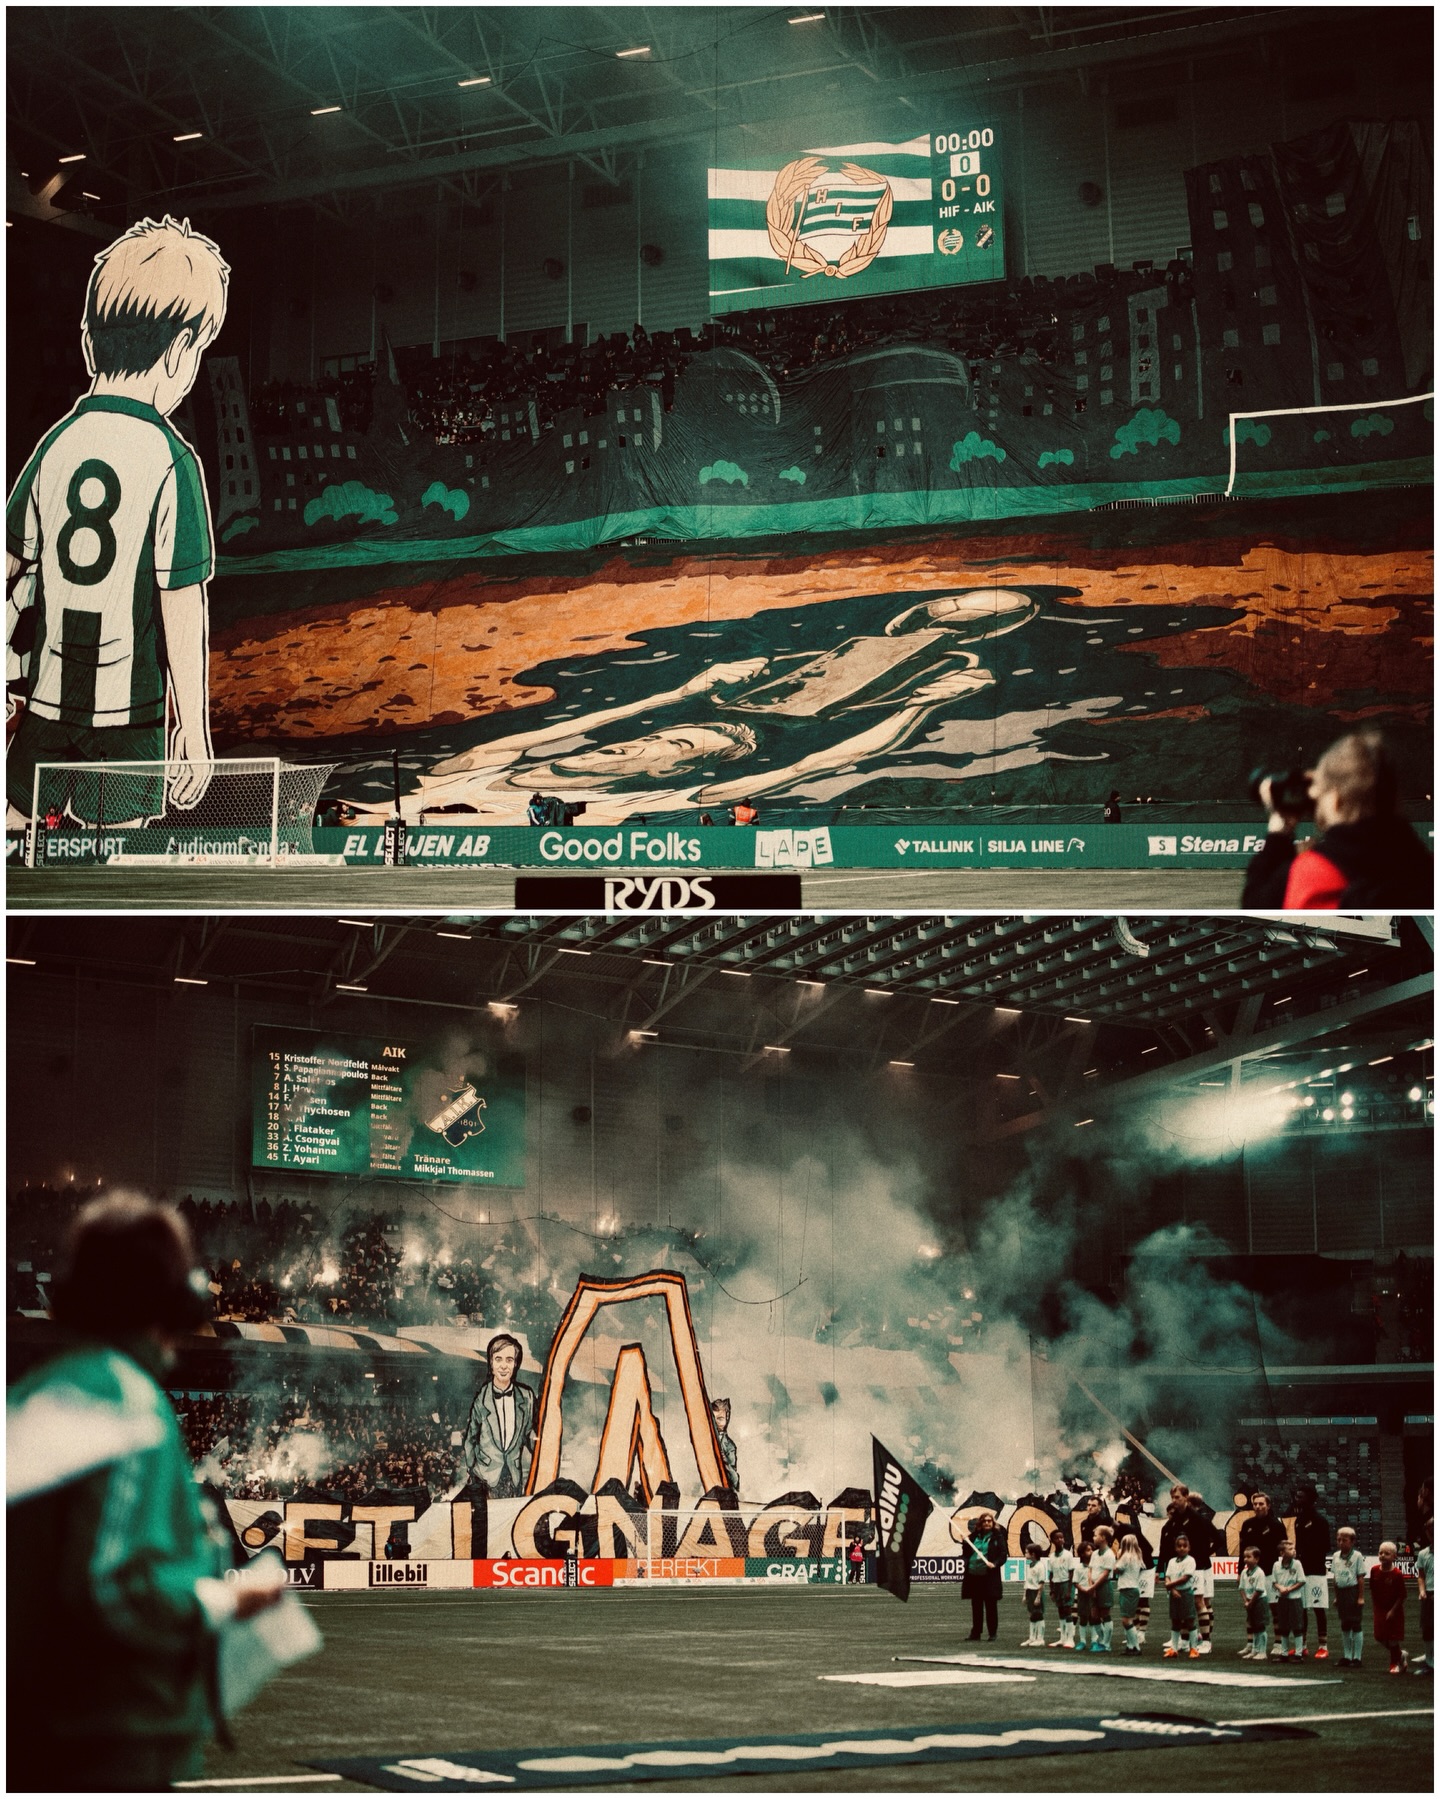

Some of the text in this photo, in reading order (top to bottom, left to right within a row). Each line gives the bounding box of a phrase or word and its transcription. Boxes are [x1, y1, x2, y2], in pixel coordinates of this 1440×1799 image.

[935, 128, 994, 154] 00:00
[960, 155, 971, 173] 0
[942, 179, 956, 201] 0
[976, 174, 990, 197] 0
[939, 205, 960, 219] HIF
[973, 200, 995, 214] AIK
[57, 458, 122, 586] 8
[36, 829, 46, 867] SELECT
[343, 834, 372, 857] EL
[456, 834, 491, 857] AB
[385, 826, 396, 865] SELECT
[397, 826, 406, 865] SELECT
[539, 831, 702, 861] Good Folks
[759, 836, 829, 858] LAPE
[912, 840, 1064, 853] TALLINK SILJA LINE
[1180, 835, 1240, 853] Stena
[604, 876, 716, 910] RYDS
[269, 1052, 400, 1073] 15 Kristoffer Nordfeldt Målvakt
[382, 1046, 406, 1059] AIK
[284, 1064, 291, 1072] S.
[371, 1073, 388, 1082] Back
[284, 1073, 293, 1082] A.
[296, 1075, 336, 1086] Saletos
[371, 1083, 402, 1093] Mittfältare
[283, 1083, 290, 1093] J.
[371, 1093, 402, 1103] Mittfältare
[284, 1093, 291, 1102] F.
[370, 1103, 388, 1111] Back
[268, 1112, 279, 1120] 18
[267, 1122, 279, 1130] 20
[294, 1124, 335, 1136] Flataker
[267, 1132, 279, 1140] 33
[295, 1134, 340, 1147] Csongvai
[267, 1142, 279, 1151] 36
[282, 1143, 291, 1152] Z.
[294, 1144, 337, 1156] Yohanna
[267, 1153, 279, 1161] 45
[282, 1153, 291, 1162] T.
[293, 1154, 319, 1165] Ayari
[414, 1154, 451, 1165] Tränare
[414, 1164, 495, 1178] Mikkjal Thomassen
[513, 1496, 877, 1558] GNAGE
[369, 1561, 428, 1588] Lillebil
[568, 1559, 577, 1587] SELECT
[637, 1558, 722, 1578] PERFEKT
[766, 1563, 834, 1579] CRAFT
